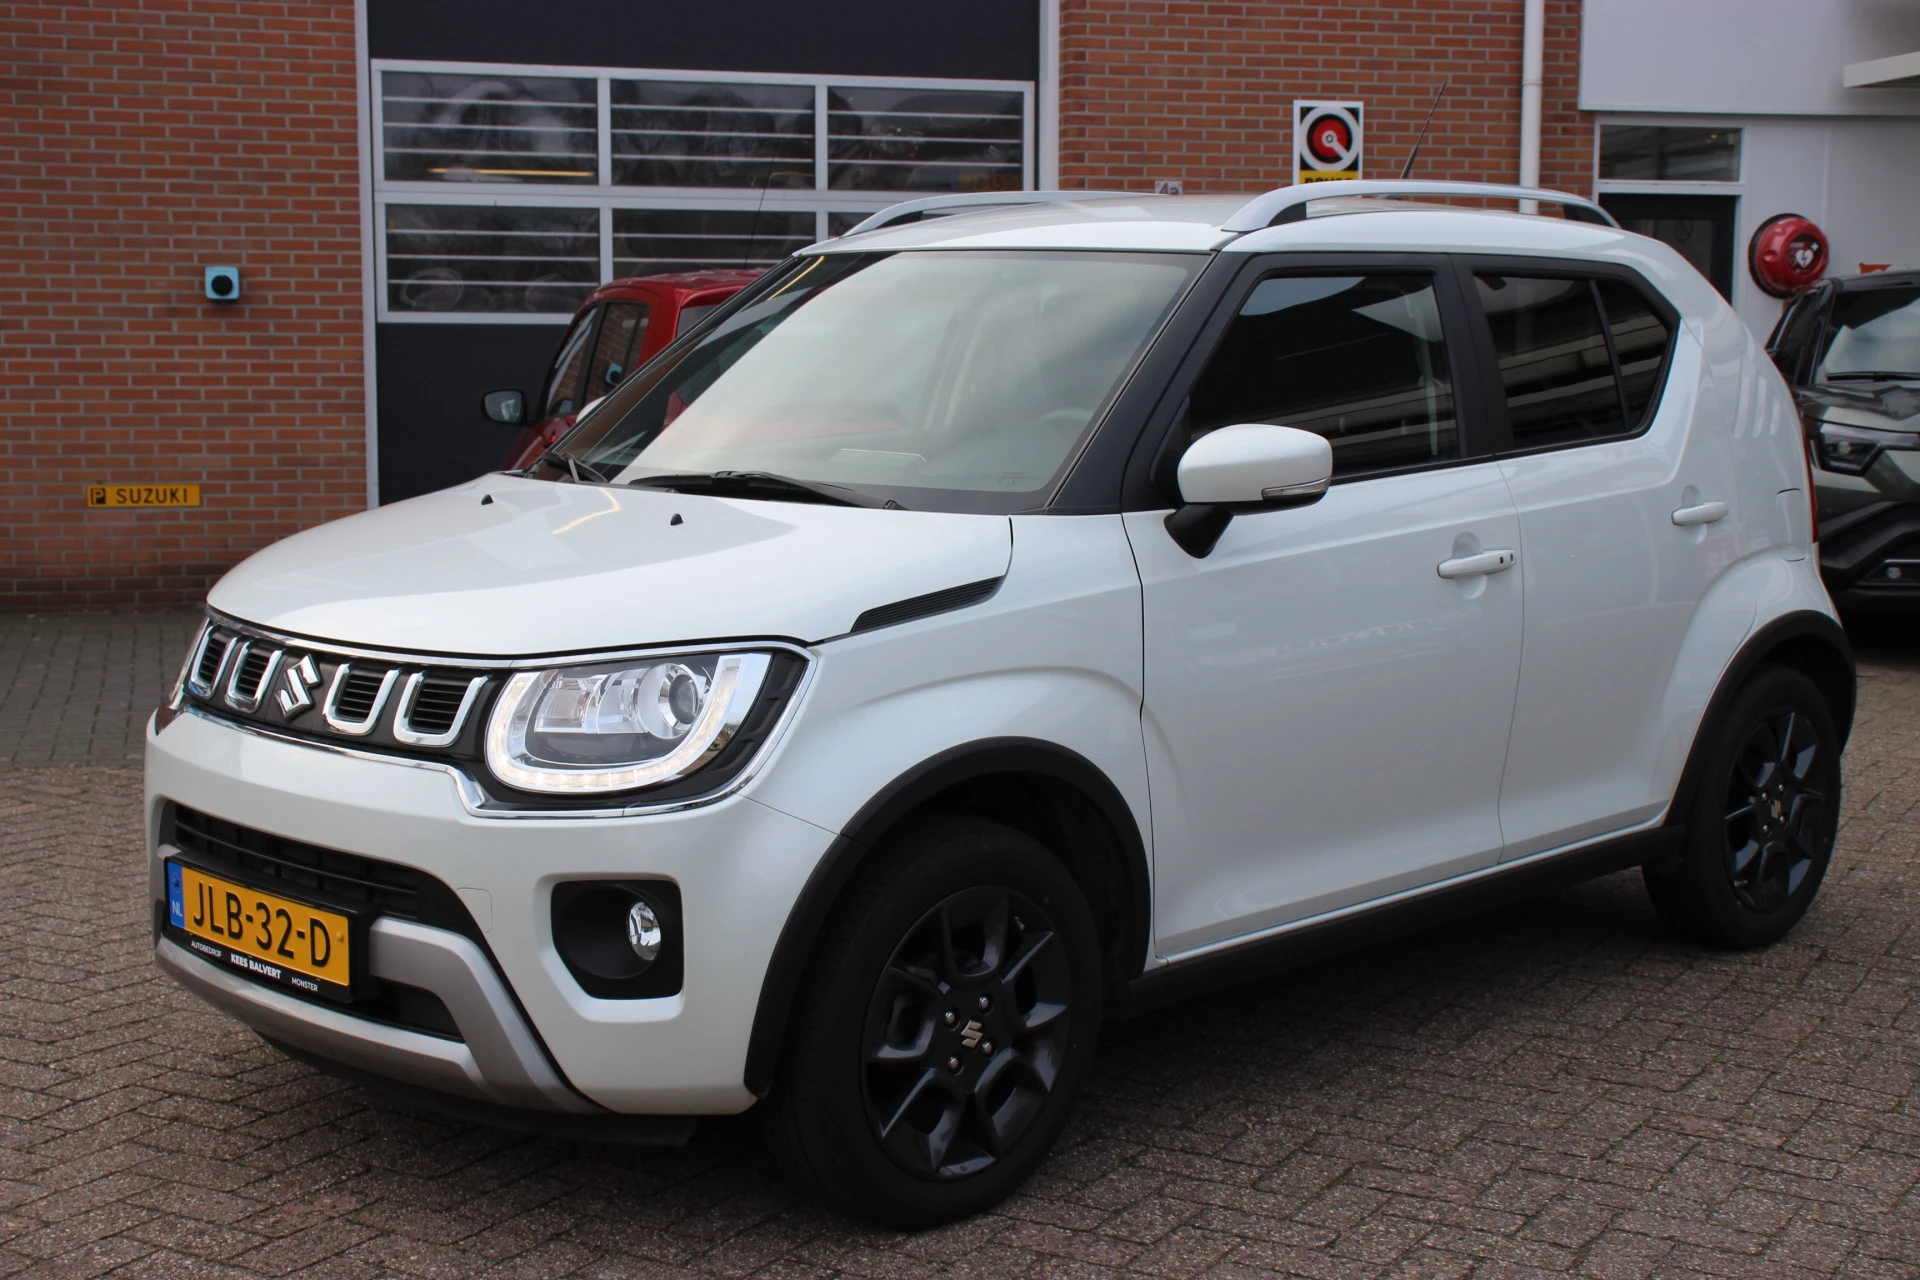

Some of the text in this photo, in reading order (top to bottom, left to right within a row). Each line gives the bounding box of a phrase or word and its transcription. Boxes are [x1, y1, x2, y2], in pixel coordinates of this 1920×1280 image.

[116, 487, 188, 505] SUZUKI
[172, 901, 183, 917] NL
[193, 881, 331, 968] JLB-32-D
[230, 953, 248, 968] KEES
[249, 959, 282, 980] BALVERT
[291, 977, 318, 992] MONSTER
